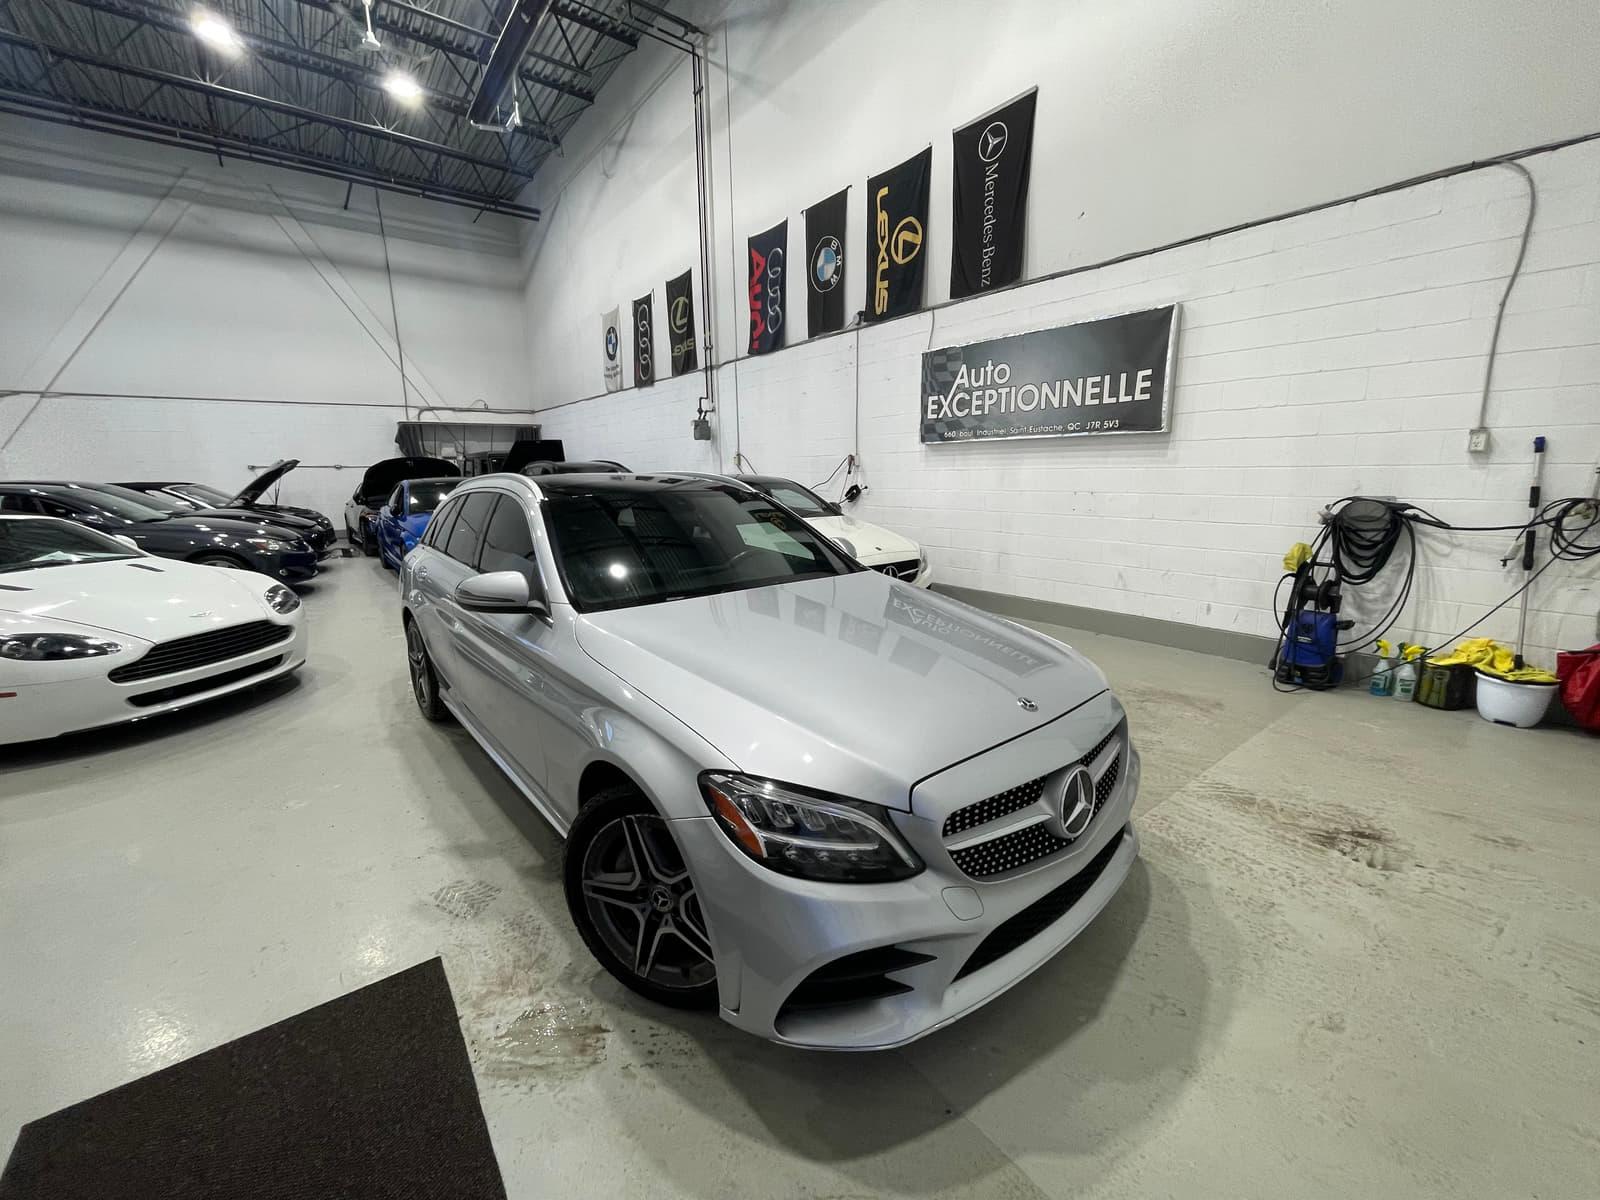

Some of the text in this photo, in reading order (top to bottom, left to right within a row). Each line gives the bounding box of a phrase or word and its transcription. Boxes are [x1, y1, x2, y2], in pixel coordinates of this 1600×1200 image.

[980, 161, 999, 288] Mercedes-Benz
[874, 186, 889, 316] LEXUS
[927, 368, 1153, 419] EXCEPTIONNELLE
[951, 359, 1011, 391] Auto
[1067, 422, 1081, 431] QC
[1086, 421, 1101, 430] J7R
[1103, 420, 1119, 429] 5V3
